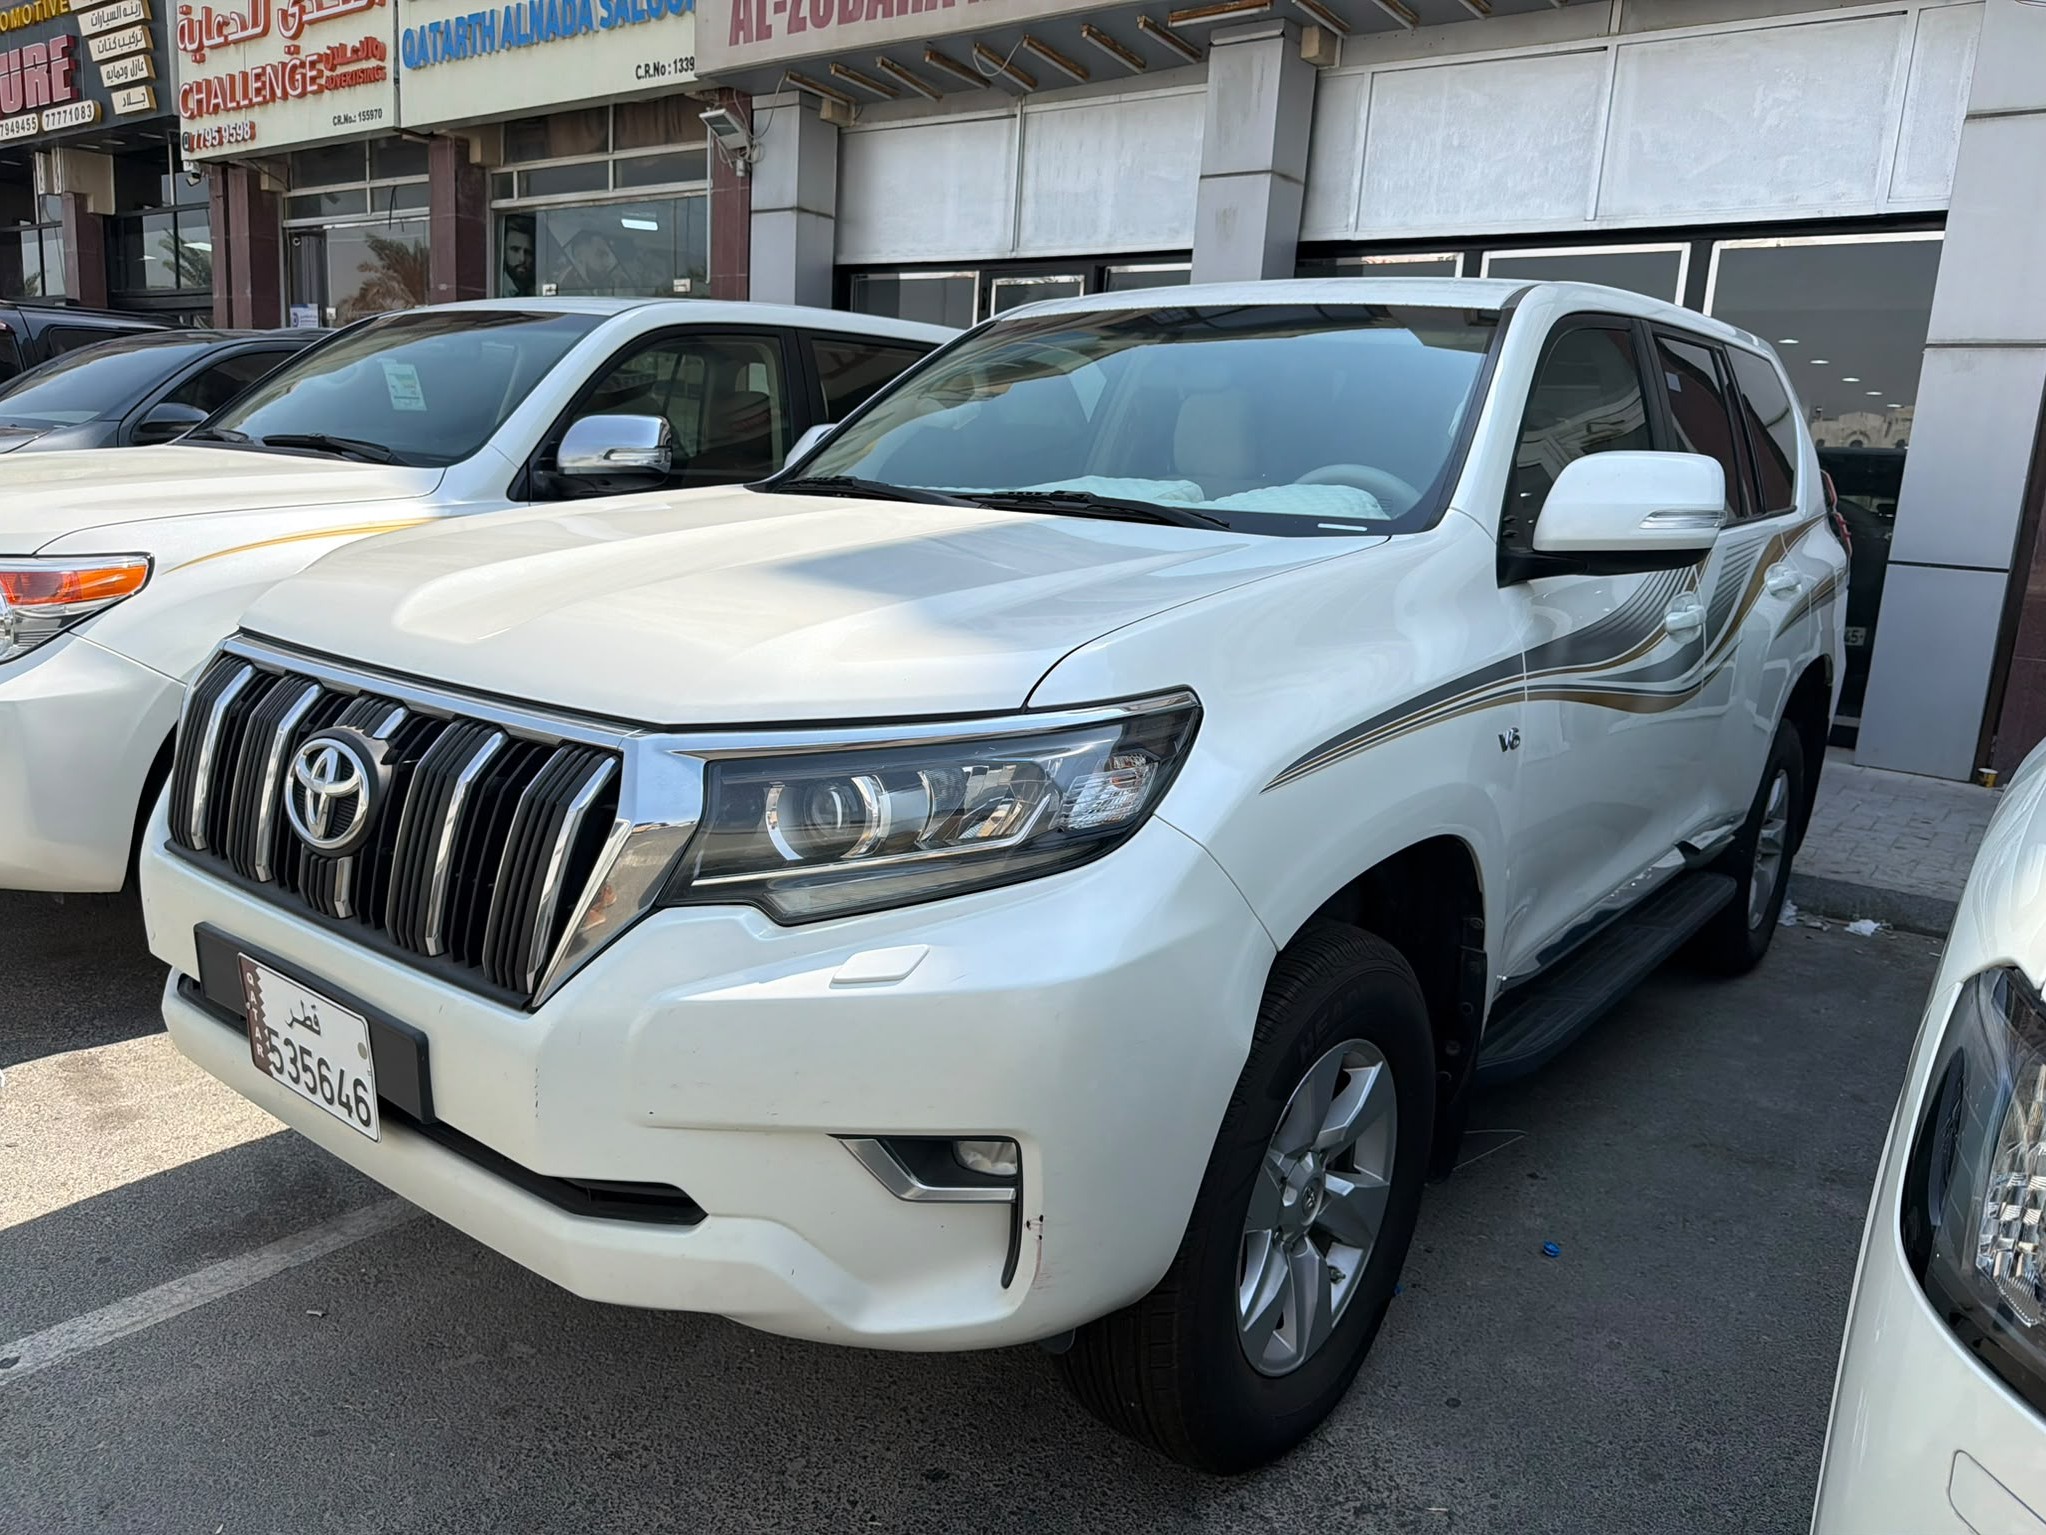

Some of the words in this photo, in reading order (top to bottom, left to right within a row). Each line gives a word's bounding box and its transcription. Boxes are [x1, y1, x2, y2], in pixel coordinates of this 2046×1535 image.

[0, 0, 69, 31] OMOTIVE
[91, 5, 121, 28] السيارات
[402, 9, 496, 69] QATARTH
[599, 0, 694, 30] SAL
[0, 35, 73, 113] URE
[673, 56, 695, 74] 1339
[178, 54, 321, 119] CHALLENGE
[0, 117, 37, 136] 7949455
[45, 104, 93, 128] 77771083
[358, 108, 383, 122] 155970
[192, 127, 220, 149] 7795
[222, 121, 252, 142] 9598
[1498, 727, 1520, 752] V6
[246, 972, 264, 1057] QATAR
[285, 1000, 321, 1035] قطر
[267, 1026, 372, 1128] 535646
